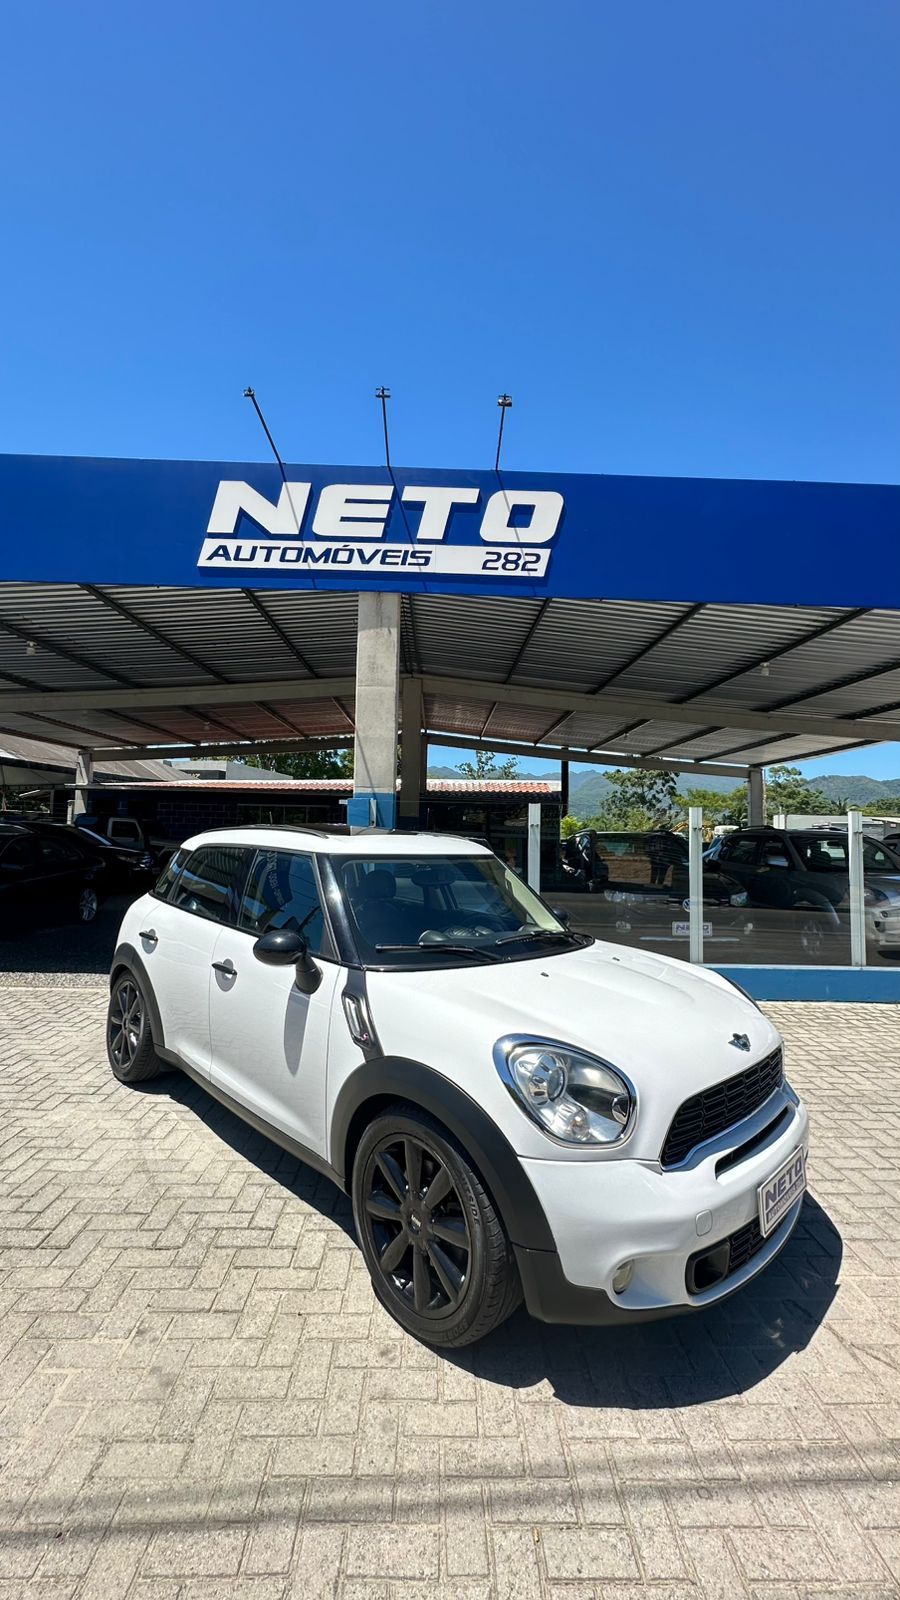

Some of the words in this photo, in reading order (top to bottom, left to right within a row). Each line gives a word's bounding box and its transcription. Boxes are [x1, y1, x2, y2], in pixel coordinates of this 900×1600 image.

[207, 480, 564, 543] NETO
[206, 544, 432, 567] AUTOMÓVEIS
[481, 551, 541, 572] 282
[766, 1156, 802, 1211] NETO
